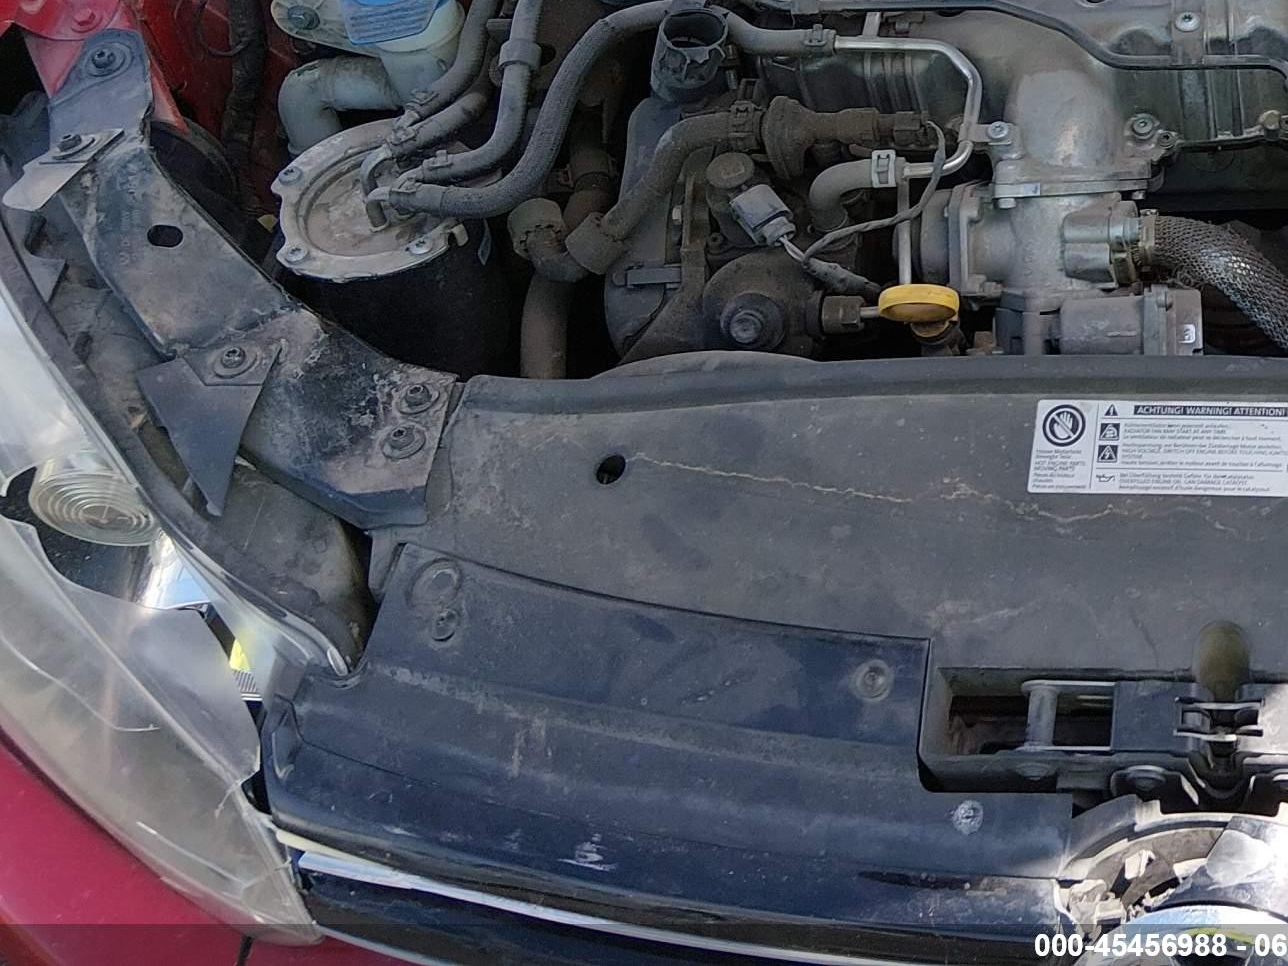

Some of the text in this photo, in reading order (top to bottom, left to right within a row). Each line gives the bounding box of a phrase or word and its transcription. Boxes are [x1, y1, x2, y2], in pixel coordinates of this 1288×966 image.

[1136, 405, 1286, 417] ACHTUNG! WARNING! ATTENTION!
